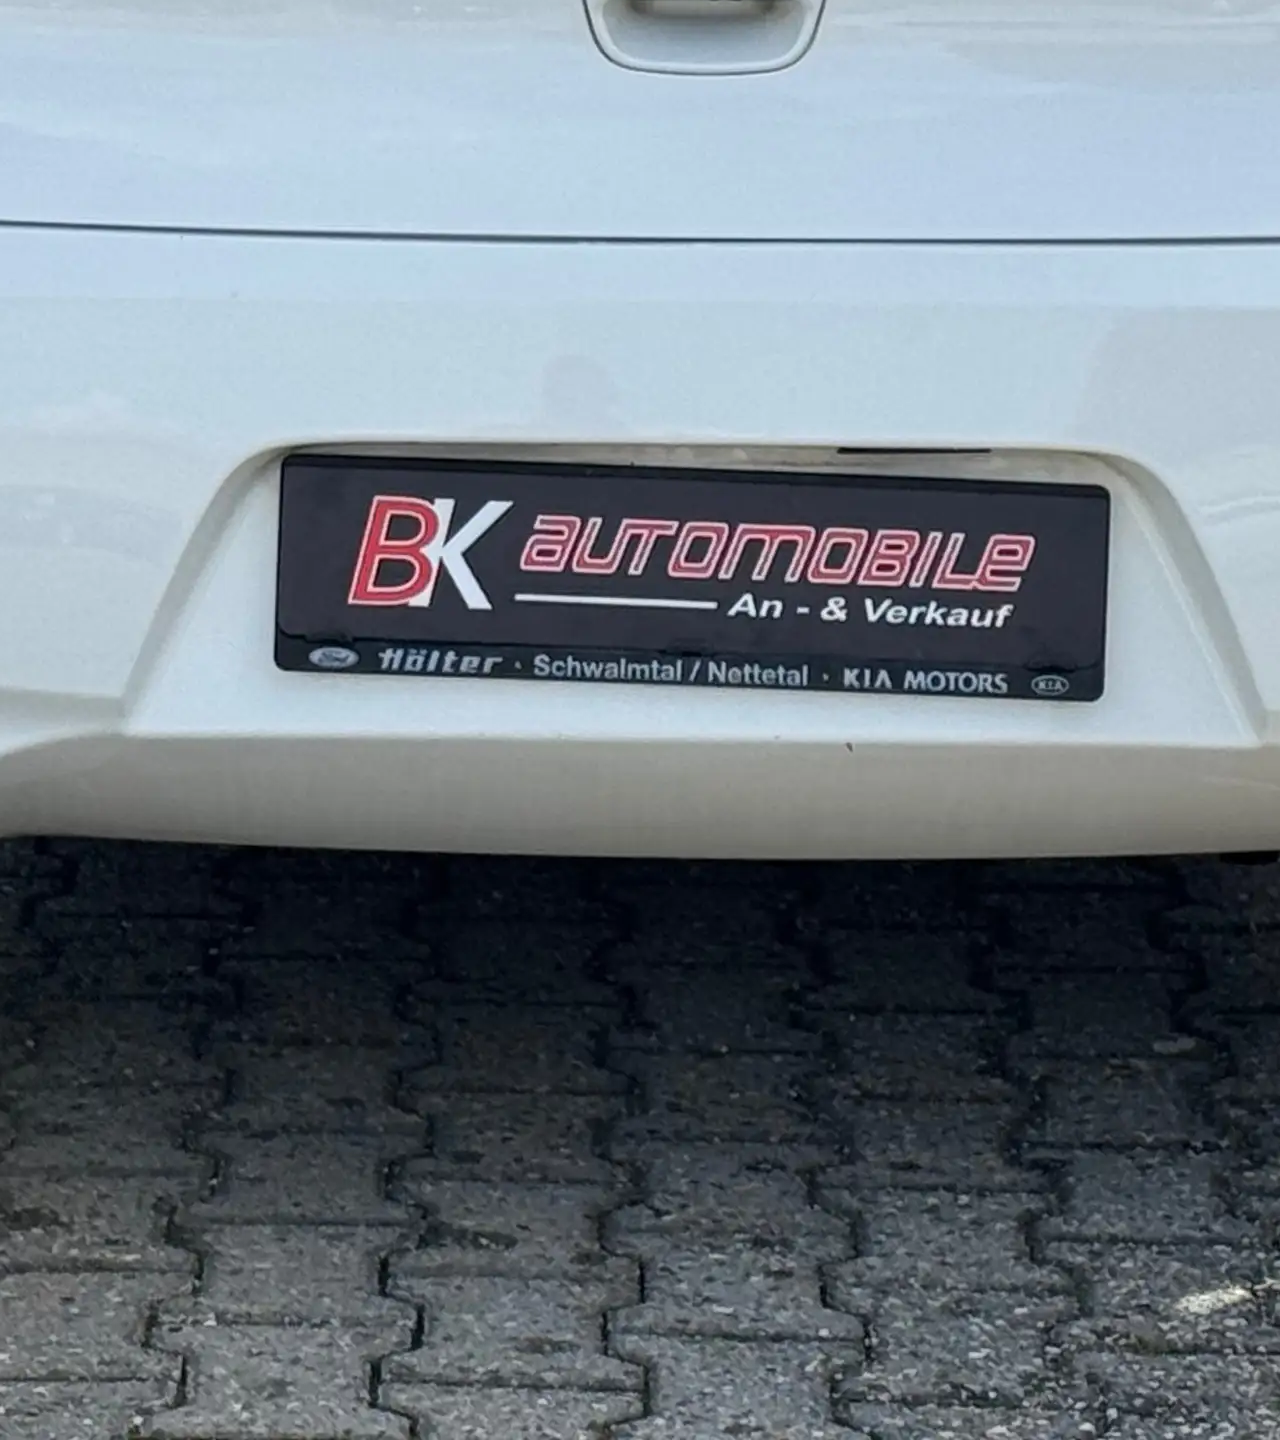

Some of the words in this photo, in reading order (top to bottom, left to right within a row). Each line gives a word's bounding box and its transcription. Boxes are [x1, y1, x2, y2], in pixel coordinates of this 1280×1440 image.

[347, 494, 514, 610] BK
[726, 592, 783, 620] An
[820, 596, 848, 623] &
[863, 597, 1015, 628] Verkauf
[378, 646, 504, 675] Hölter
[533, 654, 683, 683] Schwalmtal
[707, 661, 808, 687] Nettetal
[843, 668, 893, 690] KIA
[903, 669, 1009, 694] MOTORS
